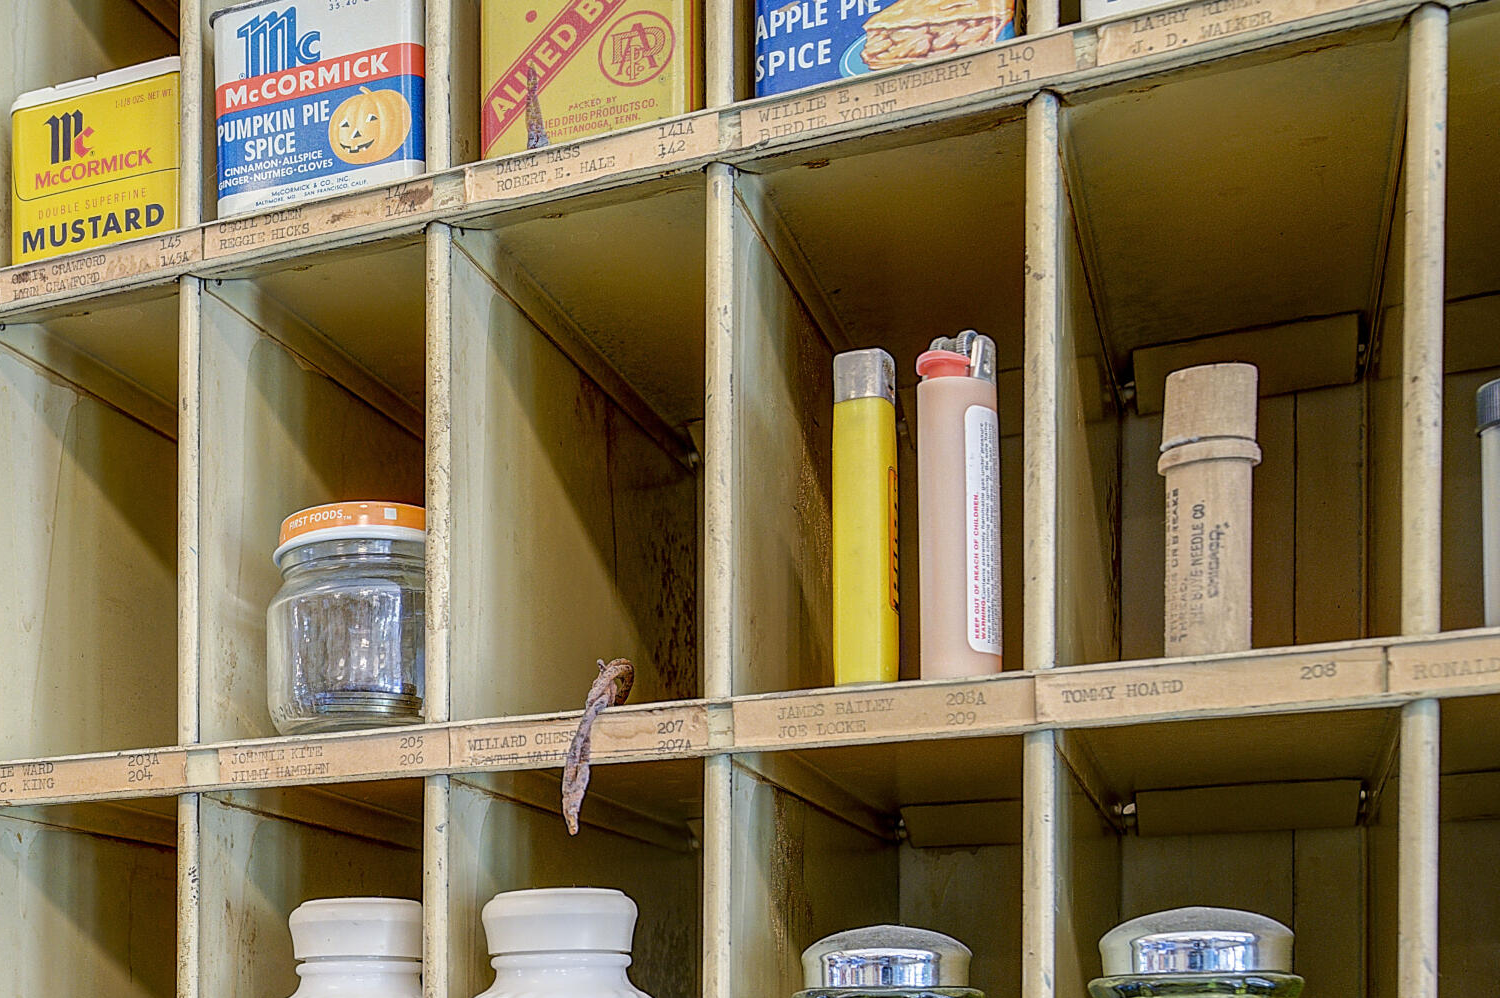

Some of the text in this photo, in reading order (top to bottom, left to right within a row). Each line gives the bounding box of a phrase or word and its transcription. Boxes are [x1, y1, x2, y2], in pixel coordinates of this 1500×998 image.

[1132, 8, 1190, 34] LARRY
[1166, 11, 1273, 48] D. WALKER
[755, 39, 832, 82] SPICE
[225, 52, 389, 108] McCORMICK
[758, 47, 1035, 123] WILLIE E. NEWBERRY 140
[148, 91, 160, 100] NET
[606, 96, 617, 104] BY
[218, 100, 330, 147] PUMPKIN PIE
[614, 113, 641, 126] TENN.
[244, 131, 295, 161] SPICE
[496, 122, 694, 176] DARYL BASS 141A
[35, 147, 152, 190] McCORMICK
[497, 156, 616, 193] ROBERT E. HALE
[38, 188, 147, 220] DOUBLE SUPERFINE
[22, 204, 164, 253] MUSTARD
[219, 218, 258, 234] CECIL
[220, 223, 310, 250] REGGIE HICKS
[52, 235, 181, 276] CRAWFORD 145
[160, 254, 189, 267] 145A
[289, 516, 308, 531] FIRST
[1125, 679, 1183, 698] HOARD
[778, 698, 895, 721] JAMES BAILEY
[946, 712, 977, 726] 209
[657, 719, 684, 735] 207
[291, 735, 425, 759] KITE 205
[468, 736, 527, 752] WILLARD
[23, 763, 54, 776] WARD
[129, 753, 159, 767] 203A
[399, 753, 425, 767] 206
[0, 782, 14, 793] C.
[23, 778, 55, 791] KING
[128, 767, 153, 782] 204
